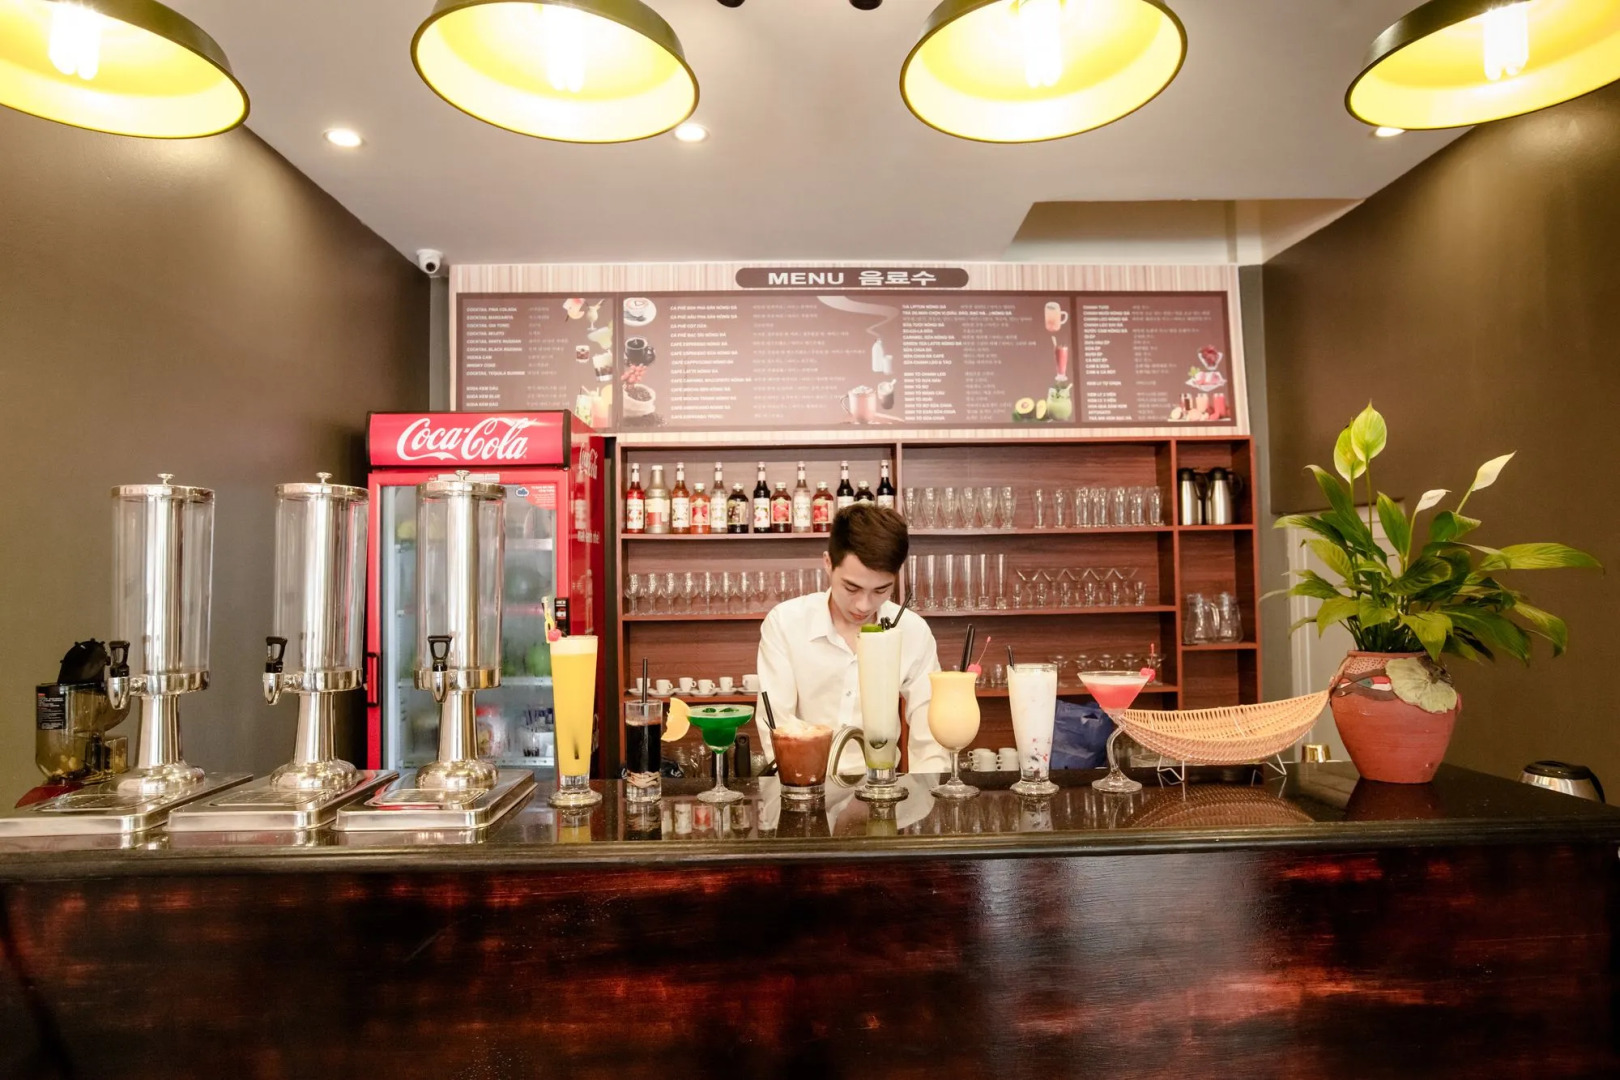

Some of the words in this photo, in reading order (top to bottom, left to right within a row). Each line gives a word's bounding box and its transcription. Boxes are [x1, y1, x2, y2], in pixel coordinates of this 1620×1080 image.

[768, 272, 844, 285] MENU
[858, 270, 937, 286] 음료수
[396, 417, 537, 461] Coca-Cola
